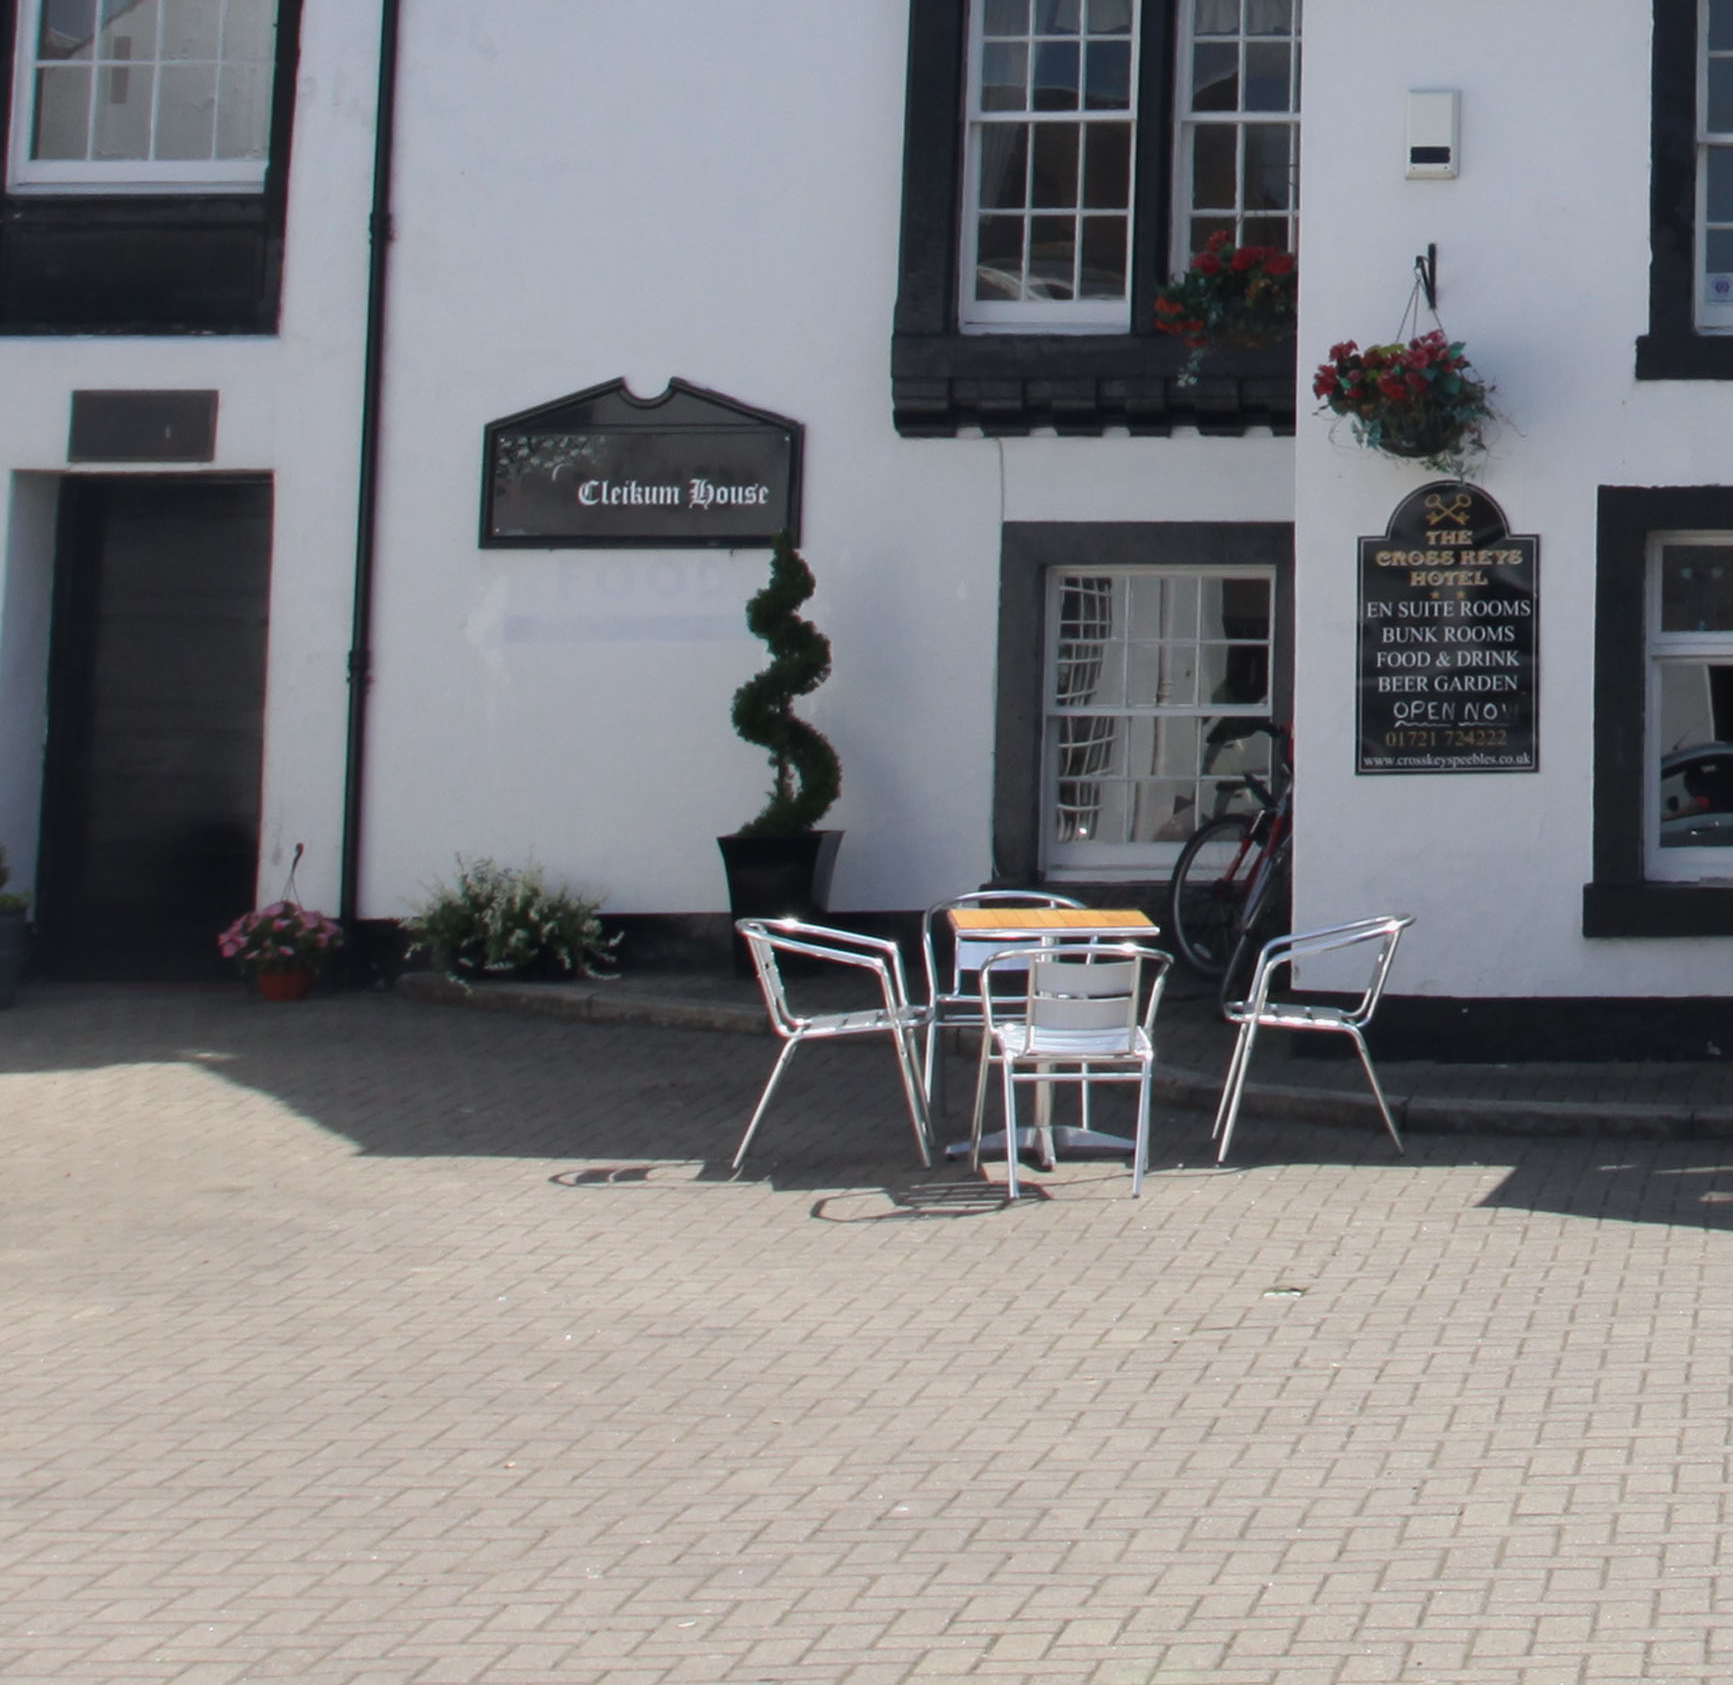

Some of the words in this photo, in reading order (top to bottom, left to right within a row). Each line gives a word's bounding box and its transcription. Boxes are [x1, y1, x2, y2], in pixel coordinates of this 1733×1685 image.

[578, 479, 680, 505] Cleikum
[688, 478, 769, 510] House
[1426, 530, 1472, 545] THE
[1375, 550, 1455, 566] CROSS
[1460, 549, 1524, 565] KEYS
[1410, 571, 1488, 586] HOTEL
[1367, 601, 1392, 618] EN
[1398, 601, 1454, 618] SUITE
[1460, 600, 1531, 616] ROOMS
[1382, 627, 1438, 643] BUNK
[1444, 626, 1515, 642] ROOMS
[1377, 651, 1431, 667] FOOD
[1436, 652, 1450, 667] &
[1457, 650, 1520, 666] DRINK
[1378, 676, 1429, 692] BEER
[1434, 675, 1518, 691] GARDEN
[1393, 701, 1456, 720] OPEN
[1385, 731, 1436, 747] 01721
[1444, 730, 1507, 746] 724222
[1363, 753, 1531, 769] www.crosskeyspeebles.co.uk
